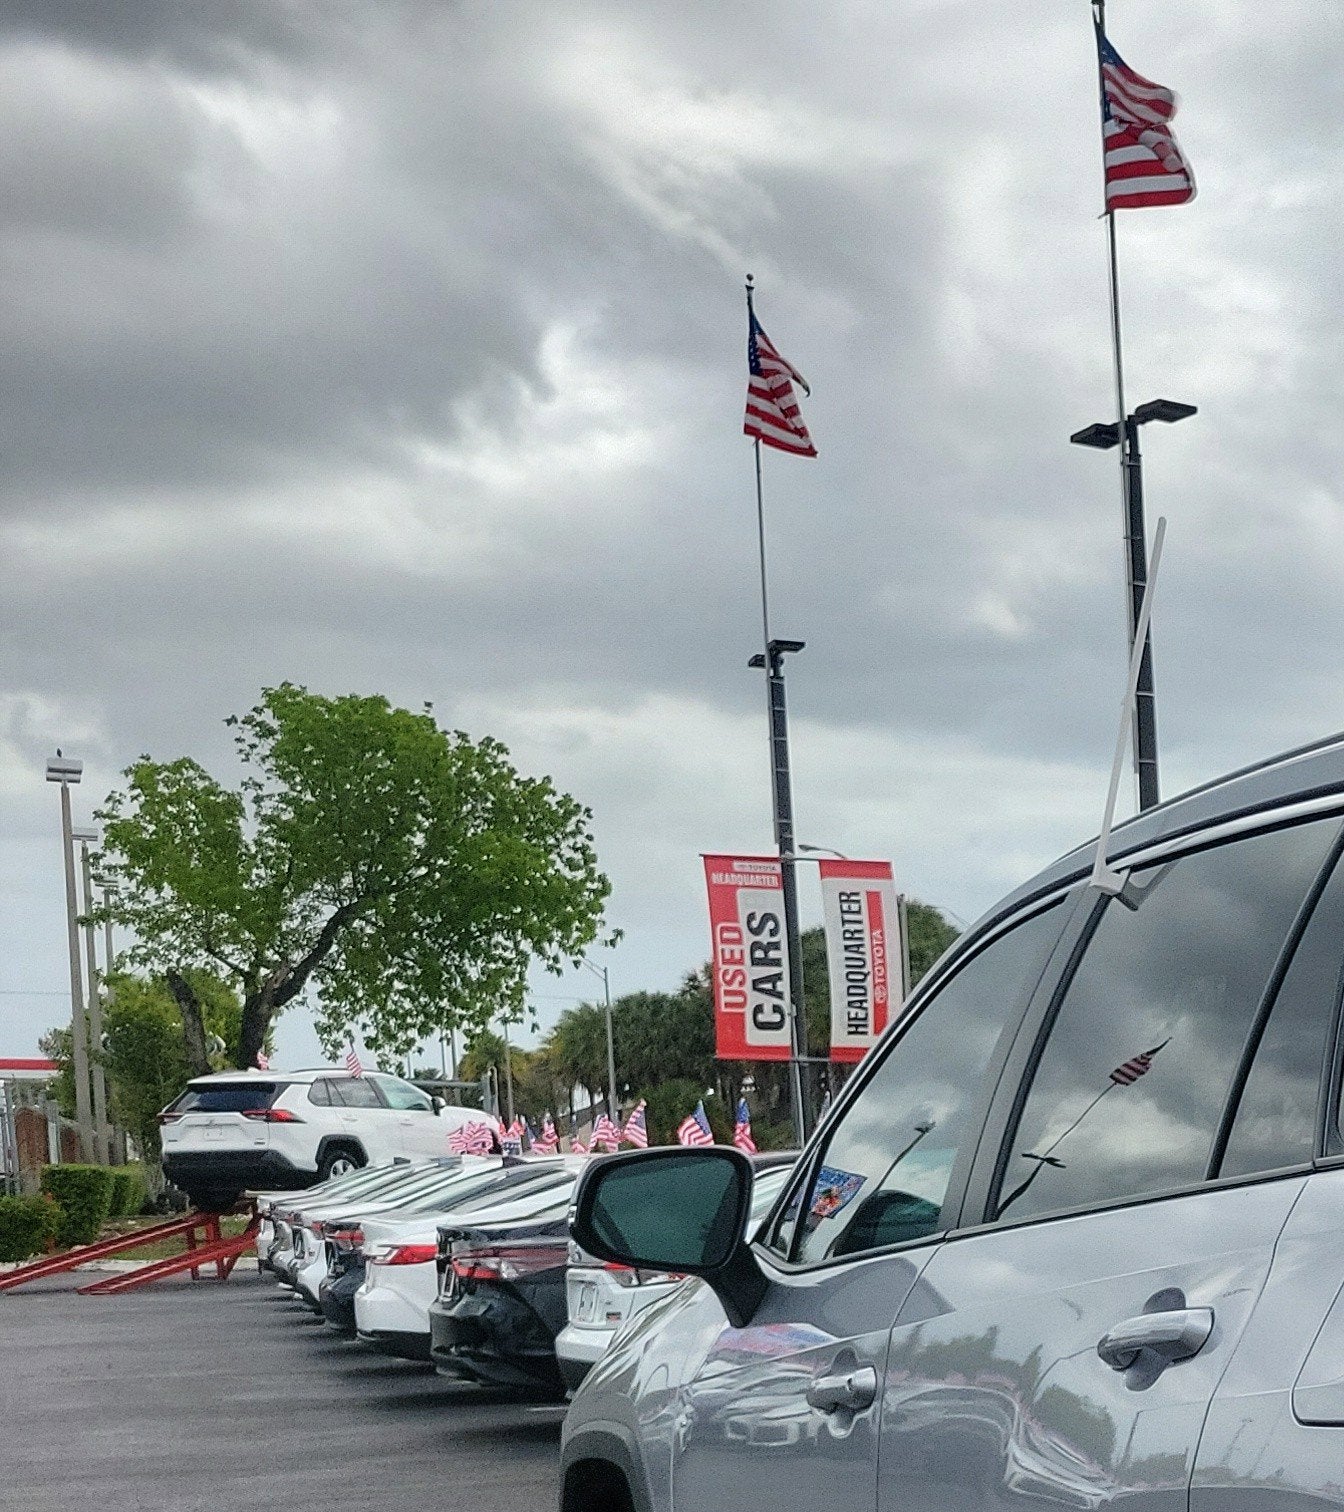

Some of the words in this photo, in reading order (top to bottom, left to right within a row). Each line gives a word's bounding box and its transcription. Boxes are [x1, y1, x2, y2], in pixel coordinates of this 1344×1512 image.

[720, 923, 747, 1012] USED
[746, 911, 786, 1032] CARS
[838, 891, 870, 1036] HEADQUARTER
[872, 929, 888, 980] TOYOTA
